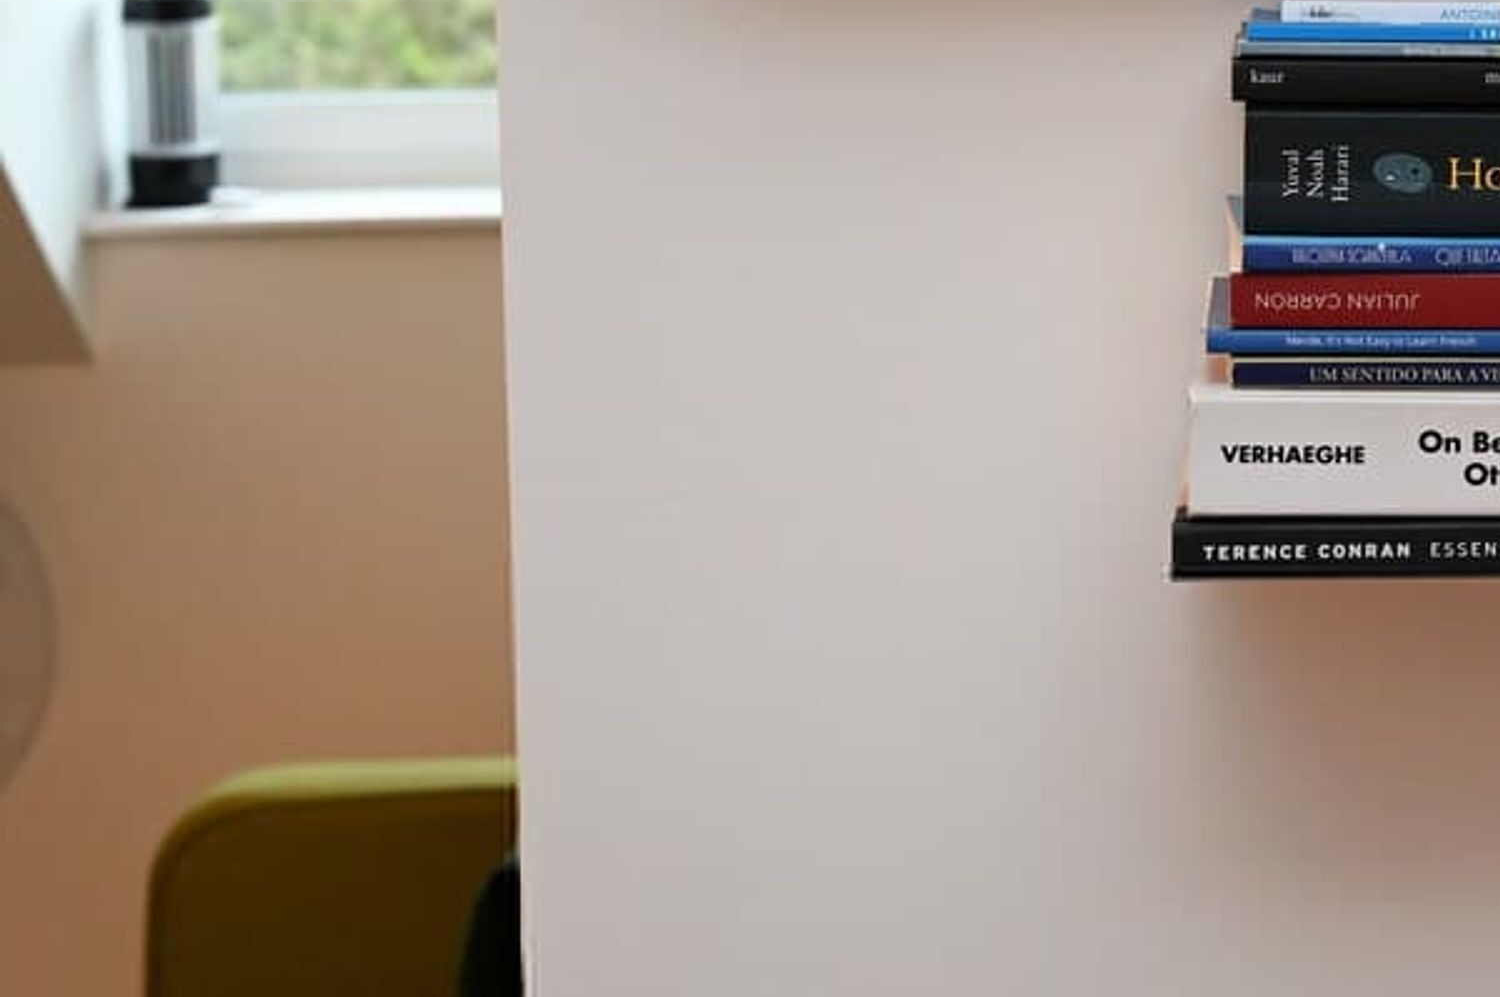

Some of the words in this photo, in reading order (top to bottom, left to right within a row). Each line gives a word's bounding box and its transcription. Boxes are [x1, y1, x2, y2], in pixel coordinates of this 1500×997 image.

[1281, 149, 1300, 198] Yuval
[1305, 149, 1324, 198] Noah
[1330, 144, 1349, 202] Harari
[1309, 366, 1338, 382] UM
[1340, 366, 1419, 382] SENTIDO
[1421, 366, 1463, 382] PARA
[1465, 367, 1479, 382] A
[1418, 430, 1462, 454] On
[1220, 445, 1366, 465] VERHAEGHE
[1203, 544, 1308, 561] TERENCE
[1317, 542, 1411, 559] CONRAN
